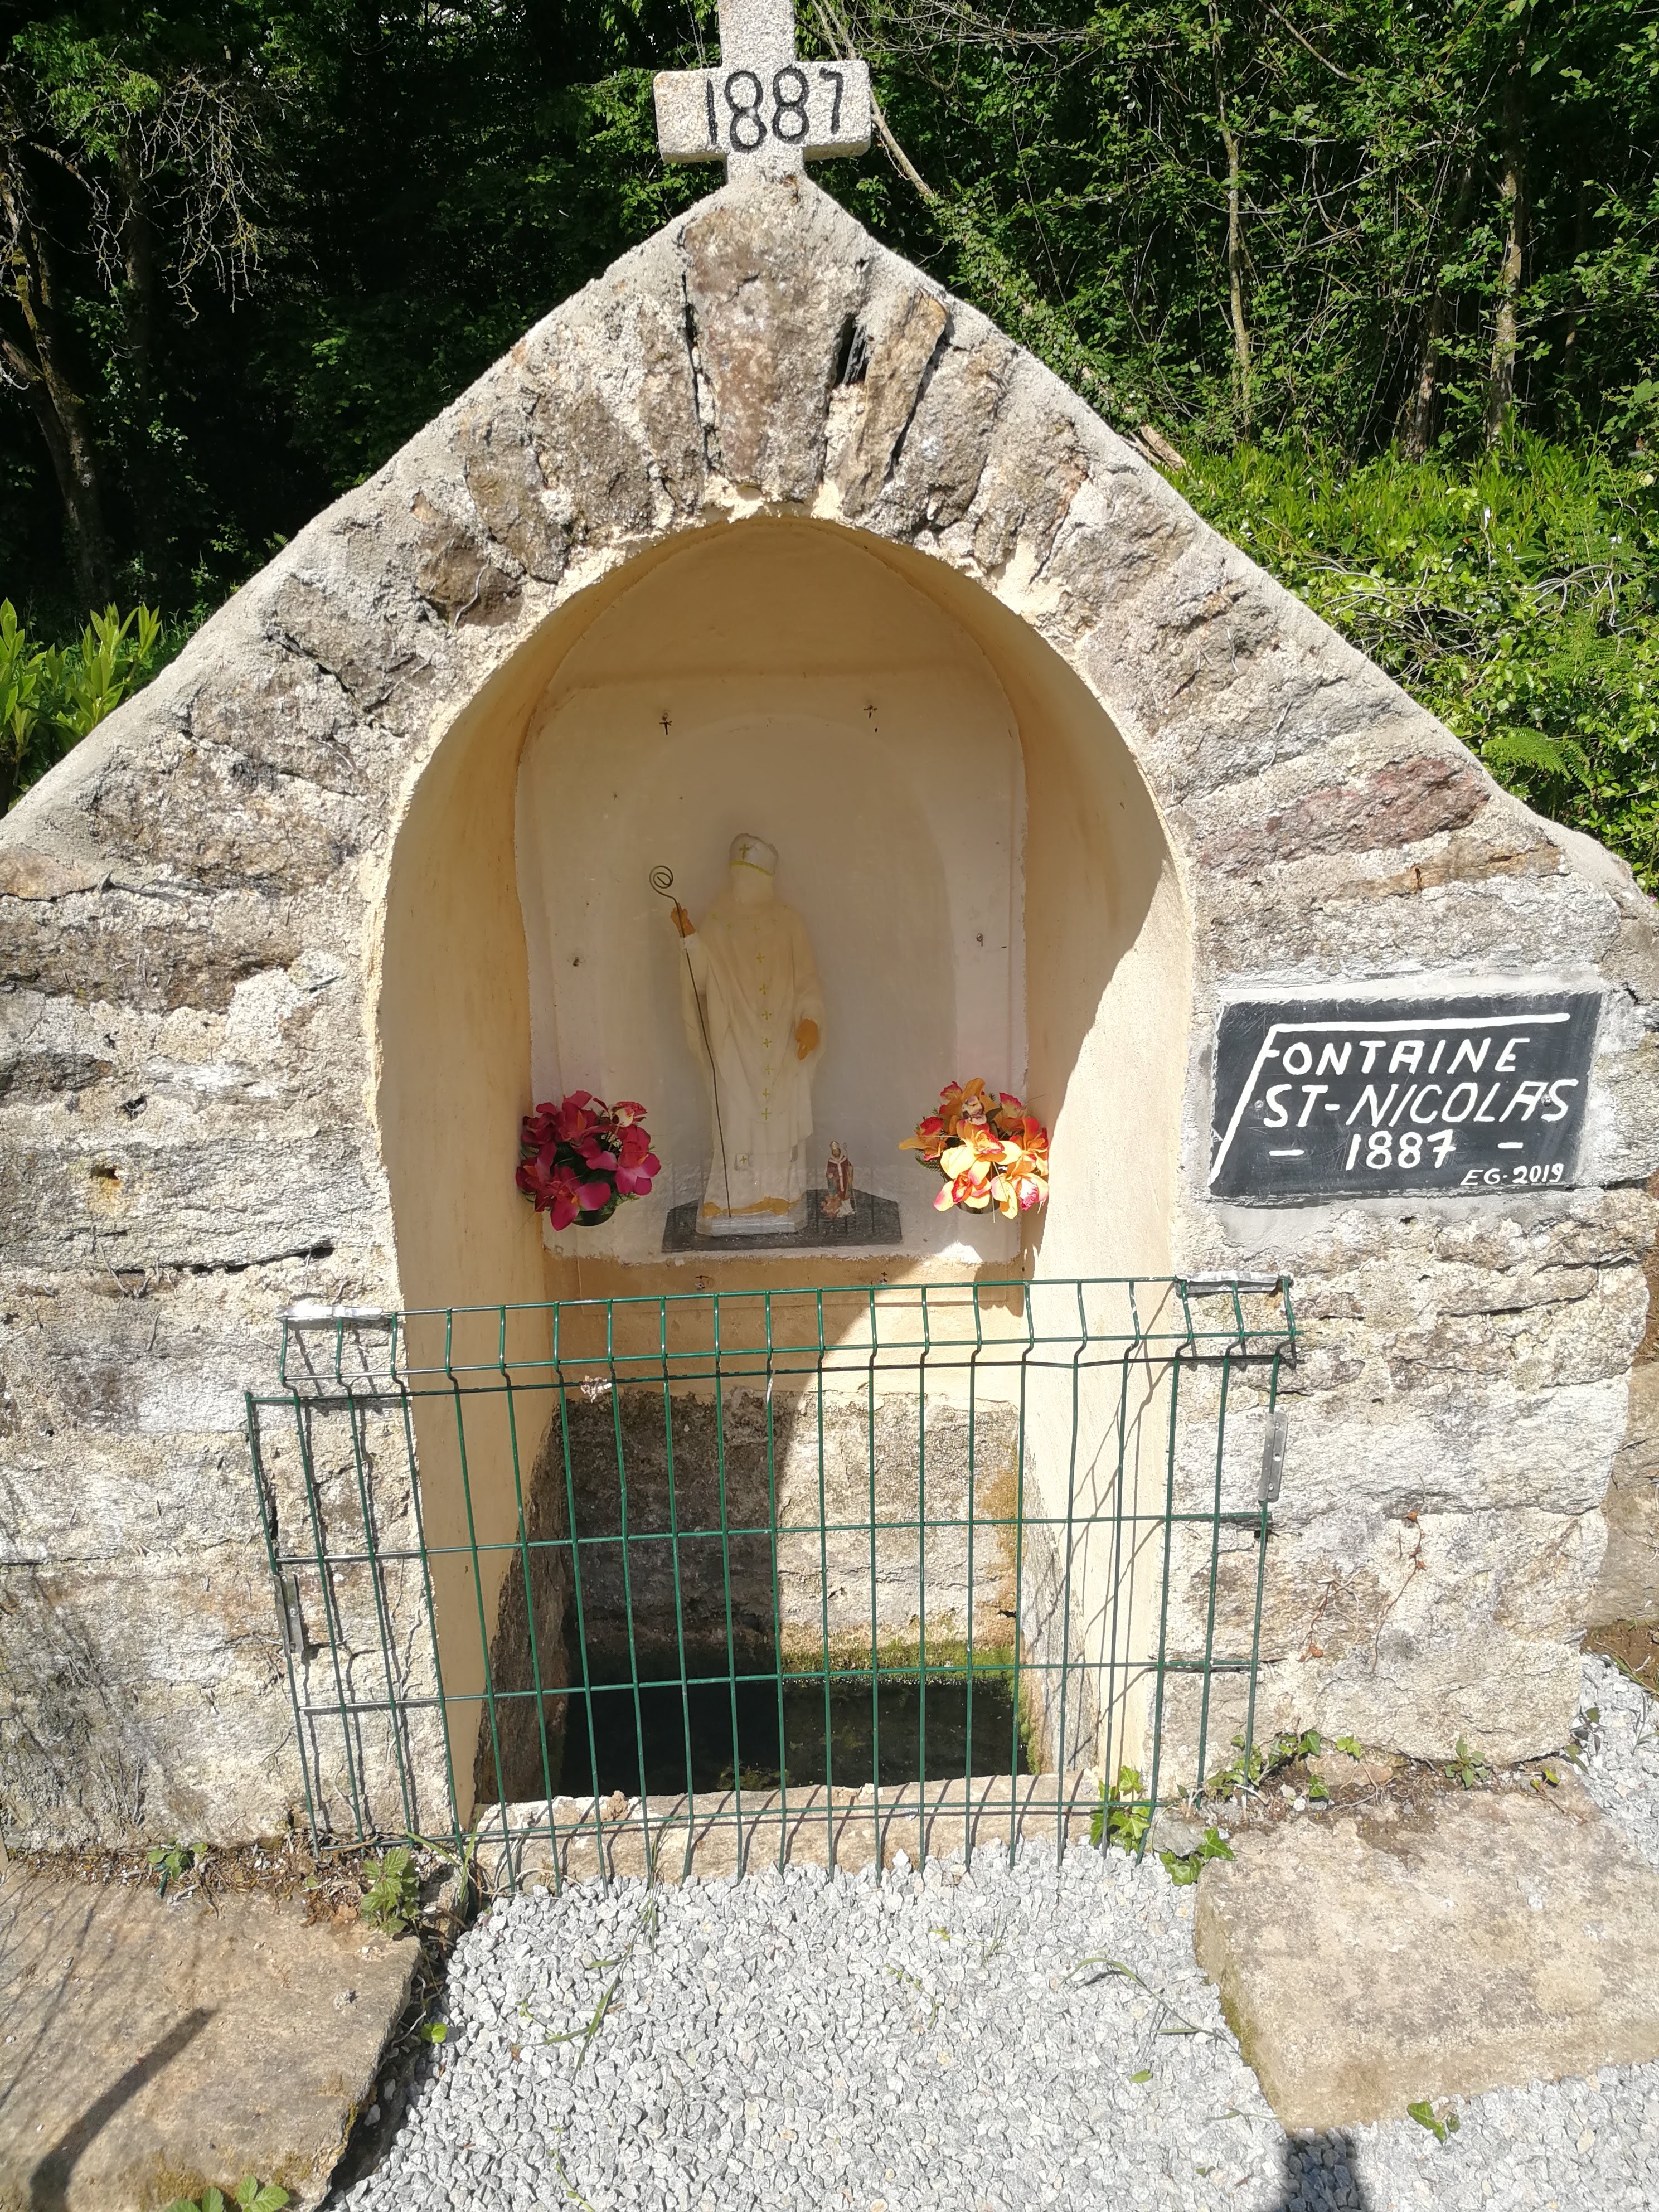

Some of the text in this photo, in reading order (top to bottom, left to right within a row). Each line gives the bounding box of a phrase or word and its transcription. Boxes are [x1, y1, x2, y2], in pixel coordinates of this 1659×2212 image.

[706, 65, 843, 152] 1887
[1263, 1079, 1579, 1128] ST-NICOLAS
[1345, 1129, 1456, 1171] 1887
